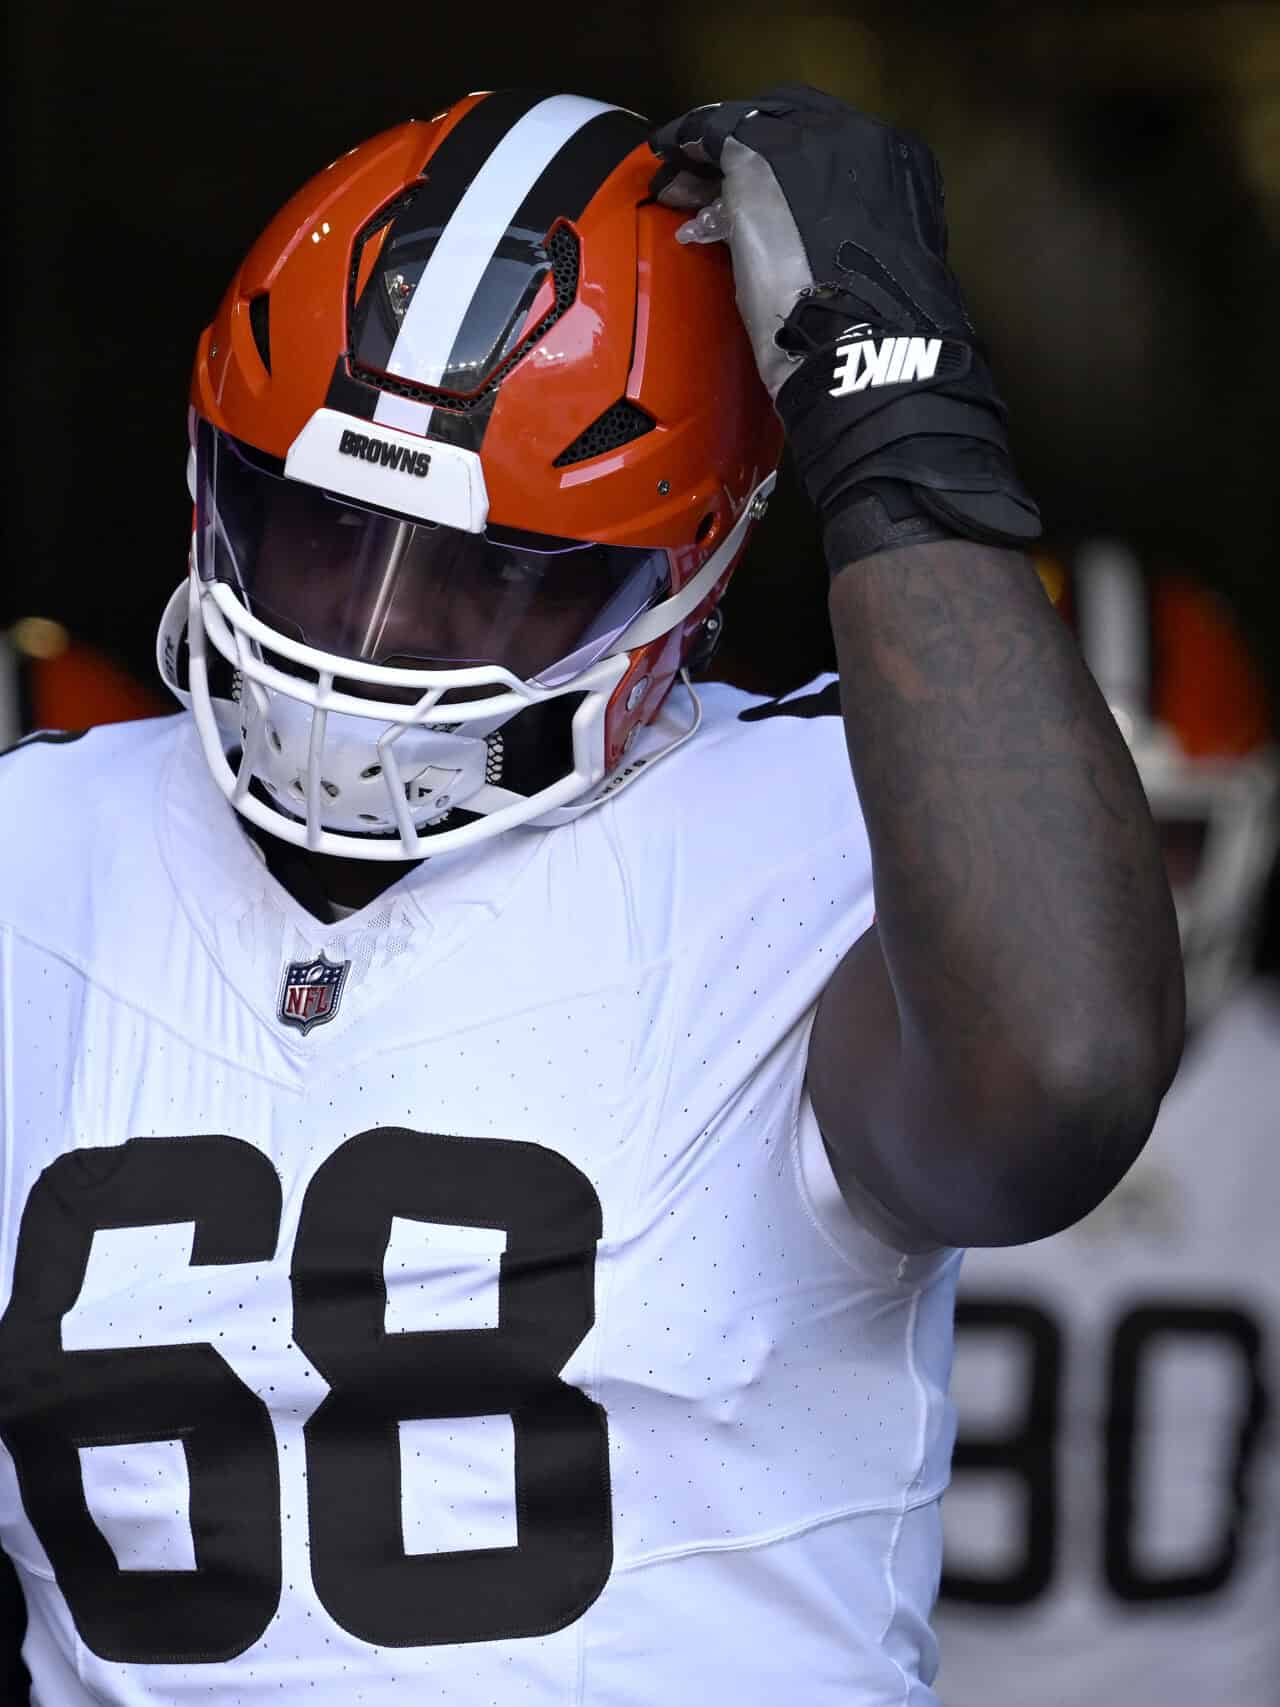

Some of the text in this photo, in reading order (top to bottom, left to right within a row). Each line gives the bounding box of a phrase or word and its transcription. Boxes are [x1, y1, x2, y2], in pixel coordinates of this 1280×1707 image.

[828, 336, 943, 397] NIKE
[338, 429, 431, 478] BROWNS
[285, 986, 331, 1018] NFL
